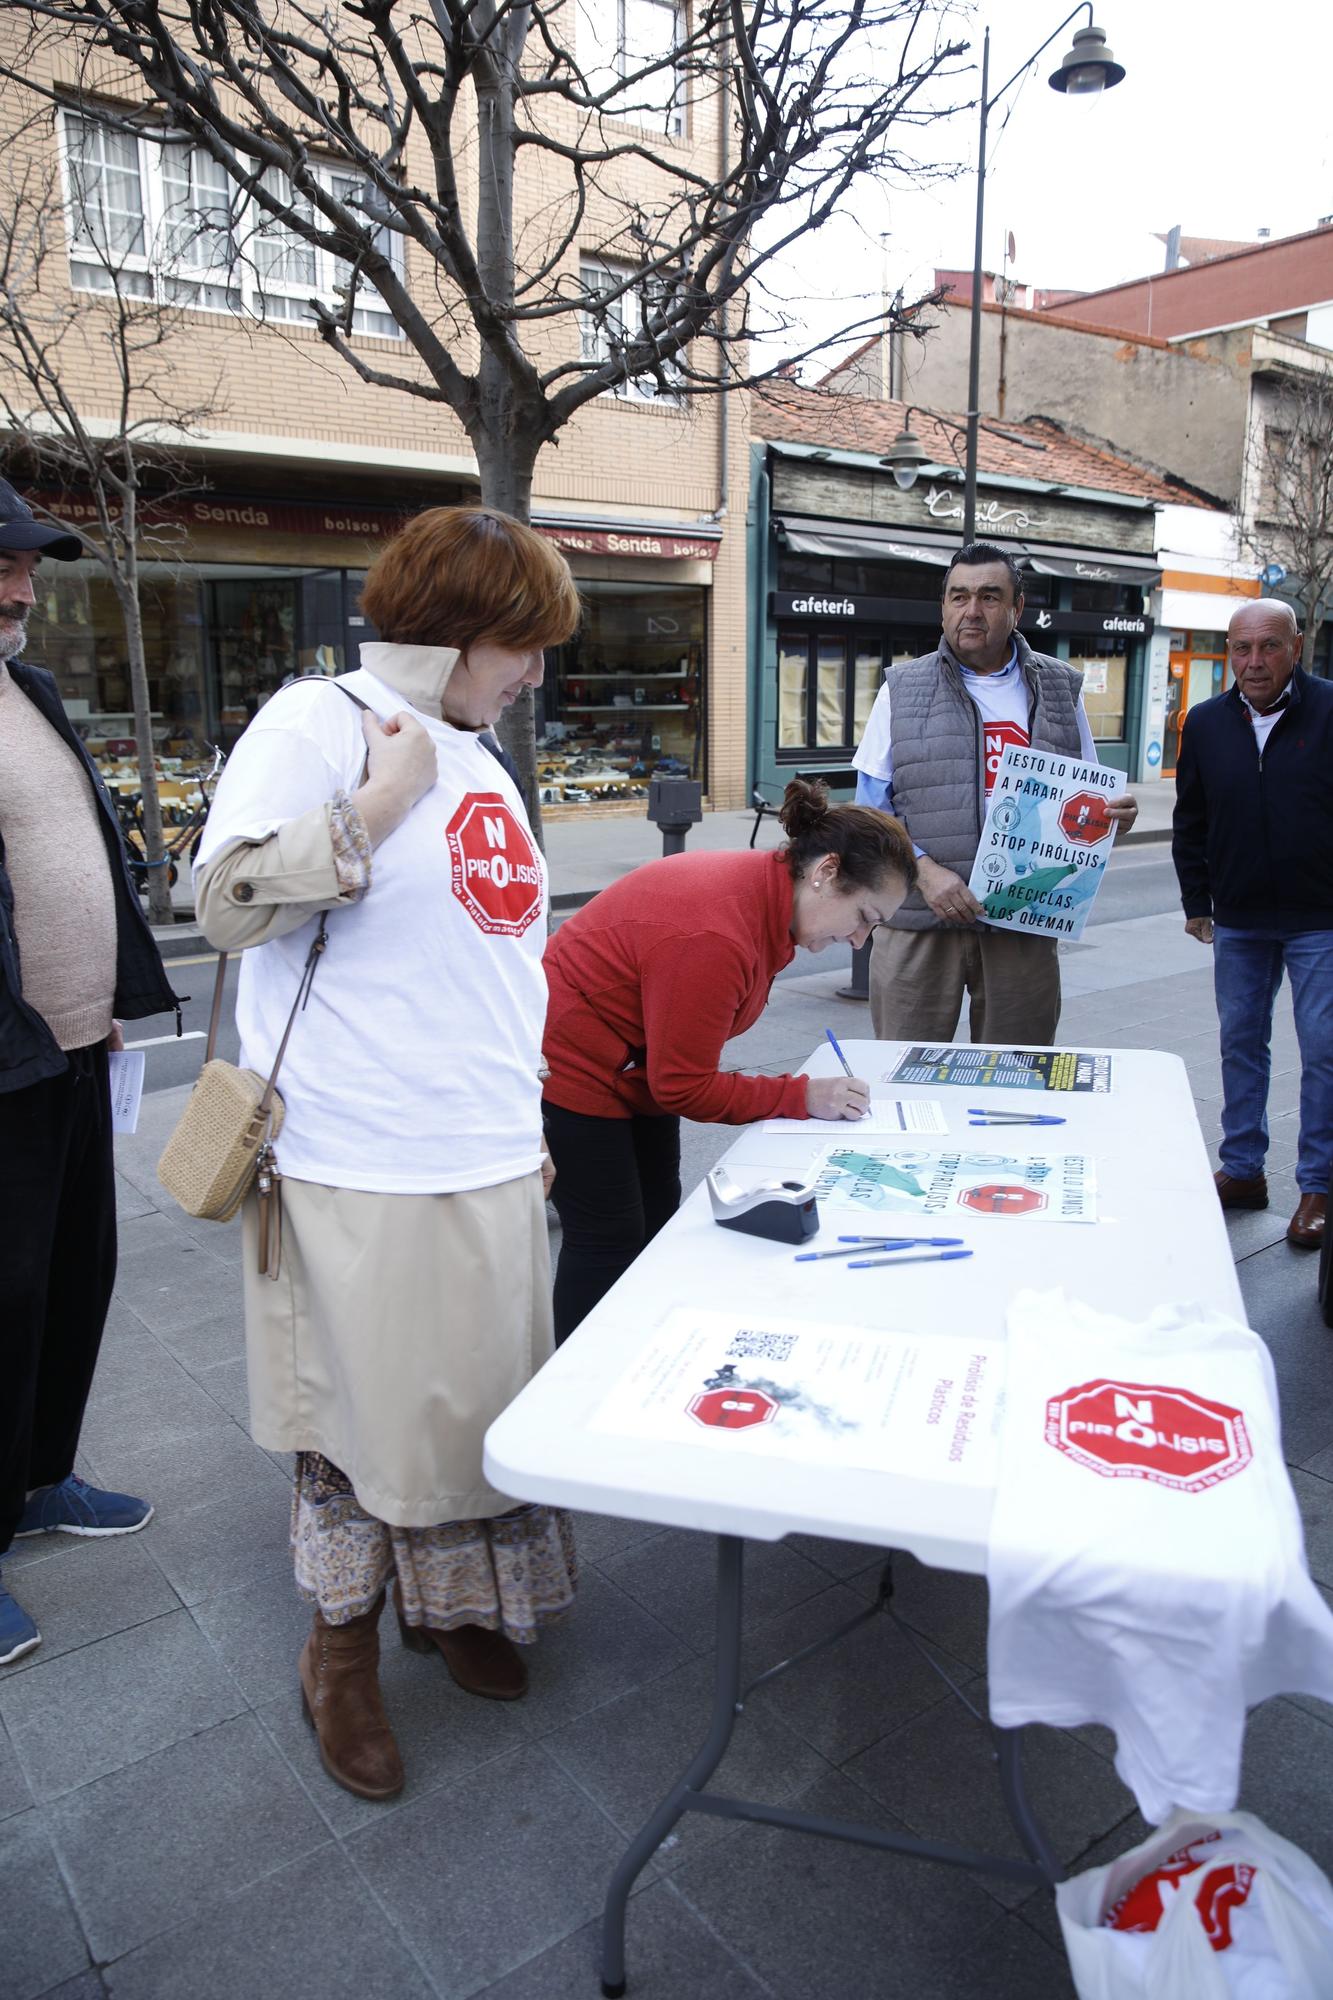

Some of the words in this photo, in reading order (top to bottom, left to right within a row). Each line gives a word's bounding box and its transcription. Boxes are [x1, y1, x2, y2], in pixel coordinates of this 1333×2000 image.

[193, 502, 270, 527] Senda
[324, 516, 381, 534] bolsos
[607, 534, 662, 554] Senda
[791, 597, 856, 616] cafetería
[1103, 617, 1145, 632] cafetería
[1007, 751, 1045, 773] ¡ESTO
[1050, 761, 1066, 777] LO
[1072, 767, 1116, 789] VAMOS
[1001, 776, 1009, 789] A
[1014, 781, 1064, 800] PARAR!
[991, 832, 1026, 852] STOP
[1031, 839, 1100, 868] PIRÓLISIS
[466, 854, 538, 889] PIROLISIS
[986, 878, 1004, 895] TÚ
[1007, 886, 1075, 911] RECICLAS,
[1019, 910, 1075, 933] QUEMAN
[939, 1153, 962, 1170] STOP
[1061, 1189, 1084, 1215] VAMOS
[961, 1394, 980, 1409] de
[1068, 1419, 1226, 1454] PIROLISIS
